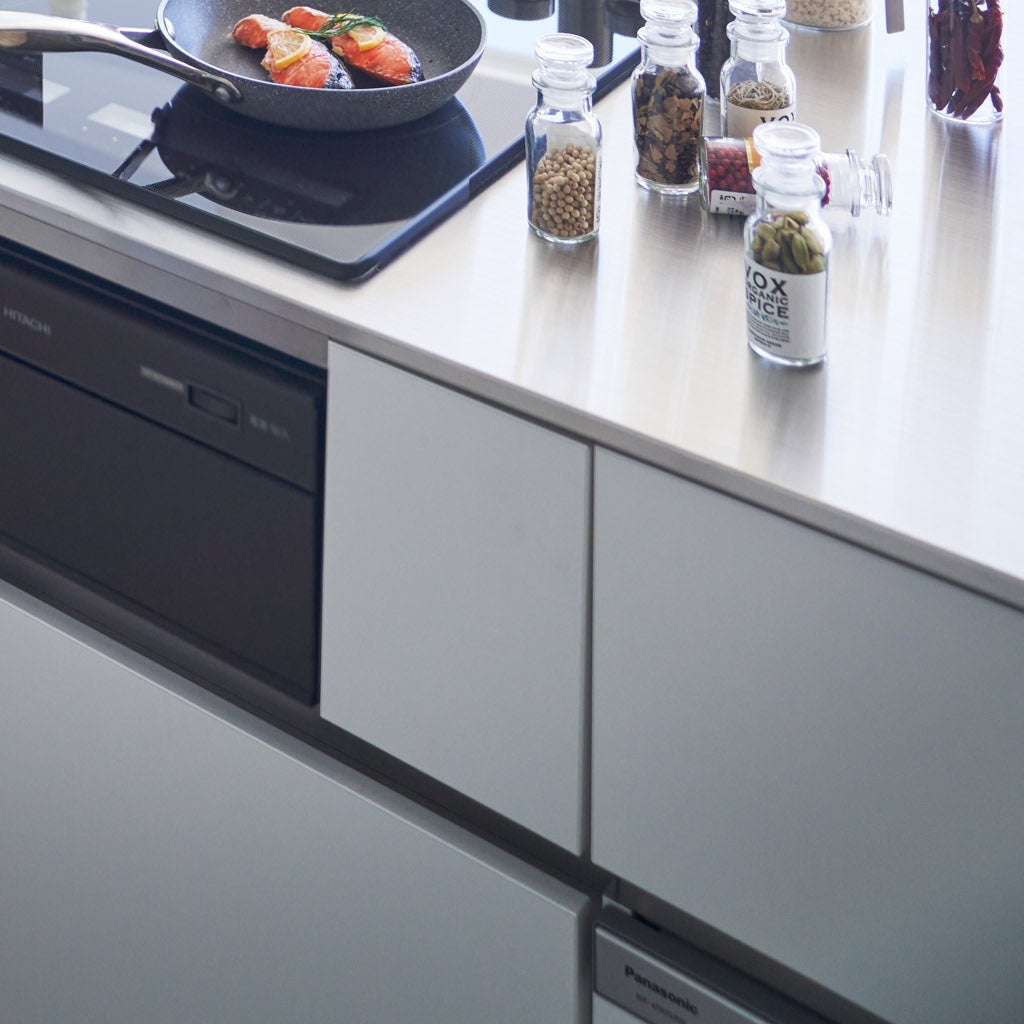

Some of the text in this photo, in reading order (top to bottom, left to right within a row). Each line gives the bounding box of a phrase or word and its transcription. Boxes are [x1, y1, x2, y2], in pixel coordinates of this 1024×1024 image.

[746, 280, 788, 306] RGANIC
[746, 287, 789, 319] PICE
[3, 307, 52, 335] HITACHI
[624, 964, 698, 1015] Panasonic
